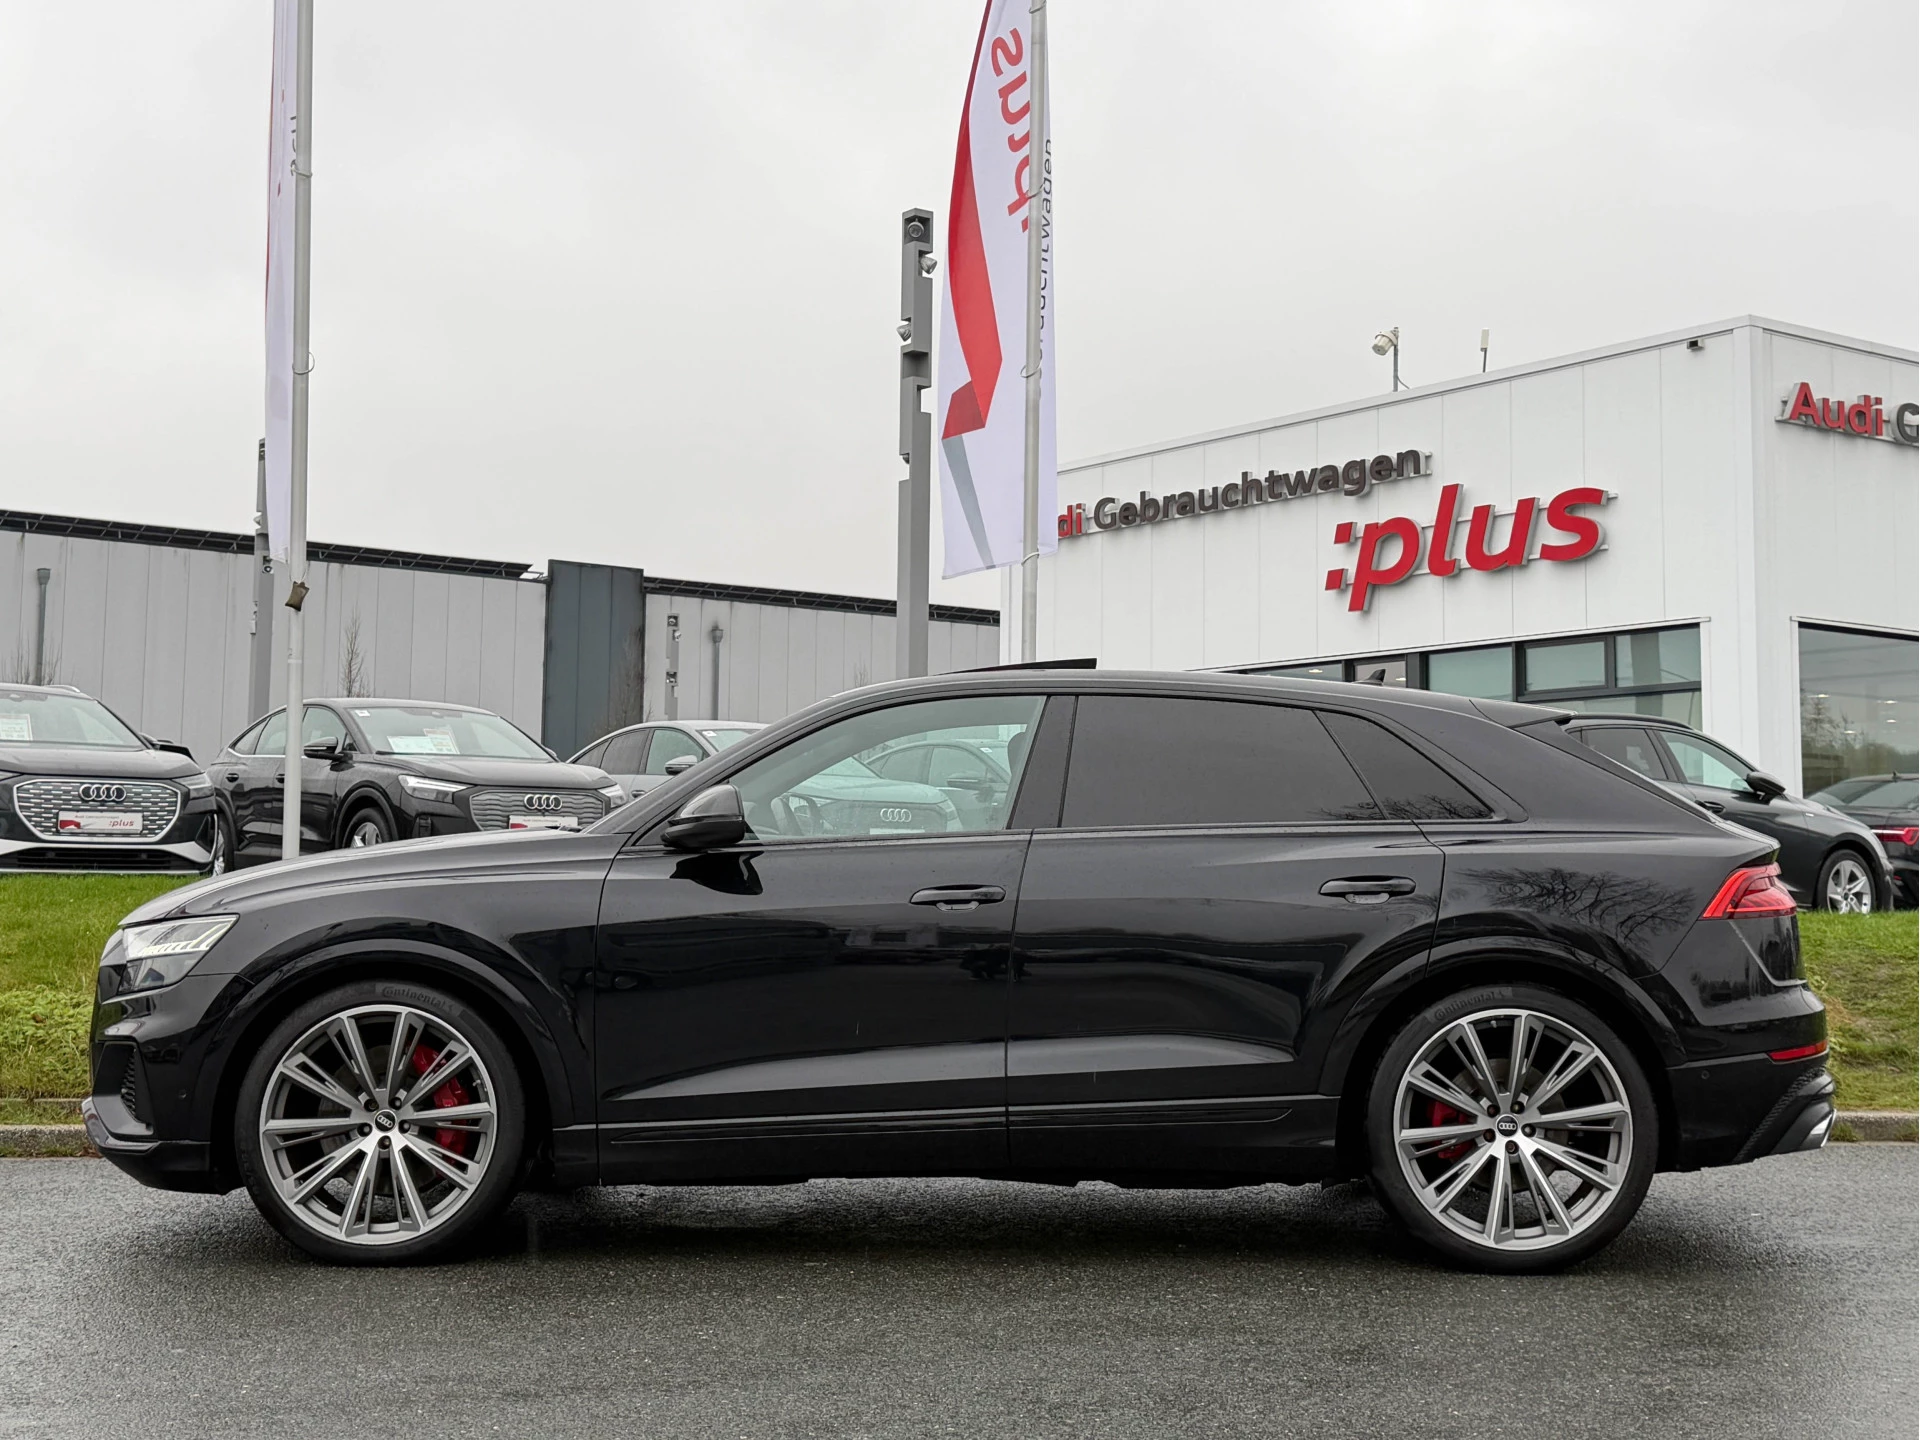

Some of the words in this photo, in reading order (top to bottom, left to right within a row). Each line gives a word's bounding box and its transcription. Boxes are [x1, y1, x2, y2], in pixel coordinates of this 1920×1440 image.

[1790, 382, 1883, 437] Audi
[1058, 503, 1083, 537] di
[1094, 449, 1421, 530] Gebrauchtwagen
[1325, 486, 1607, 612] :plus
